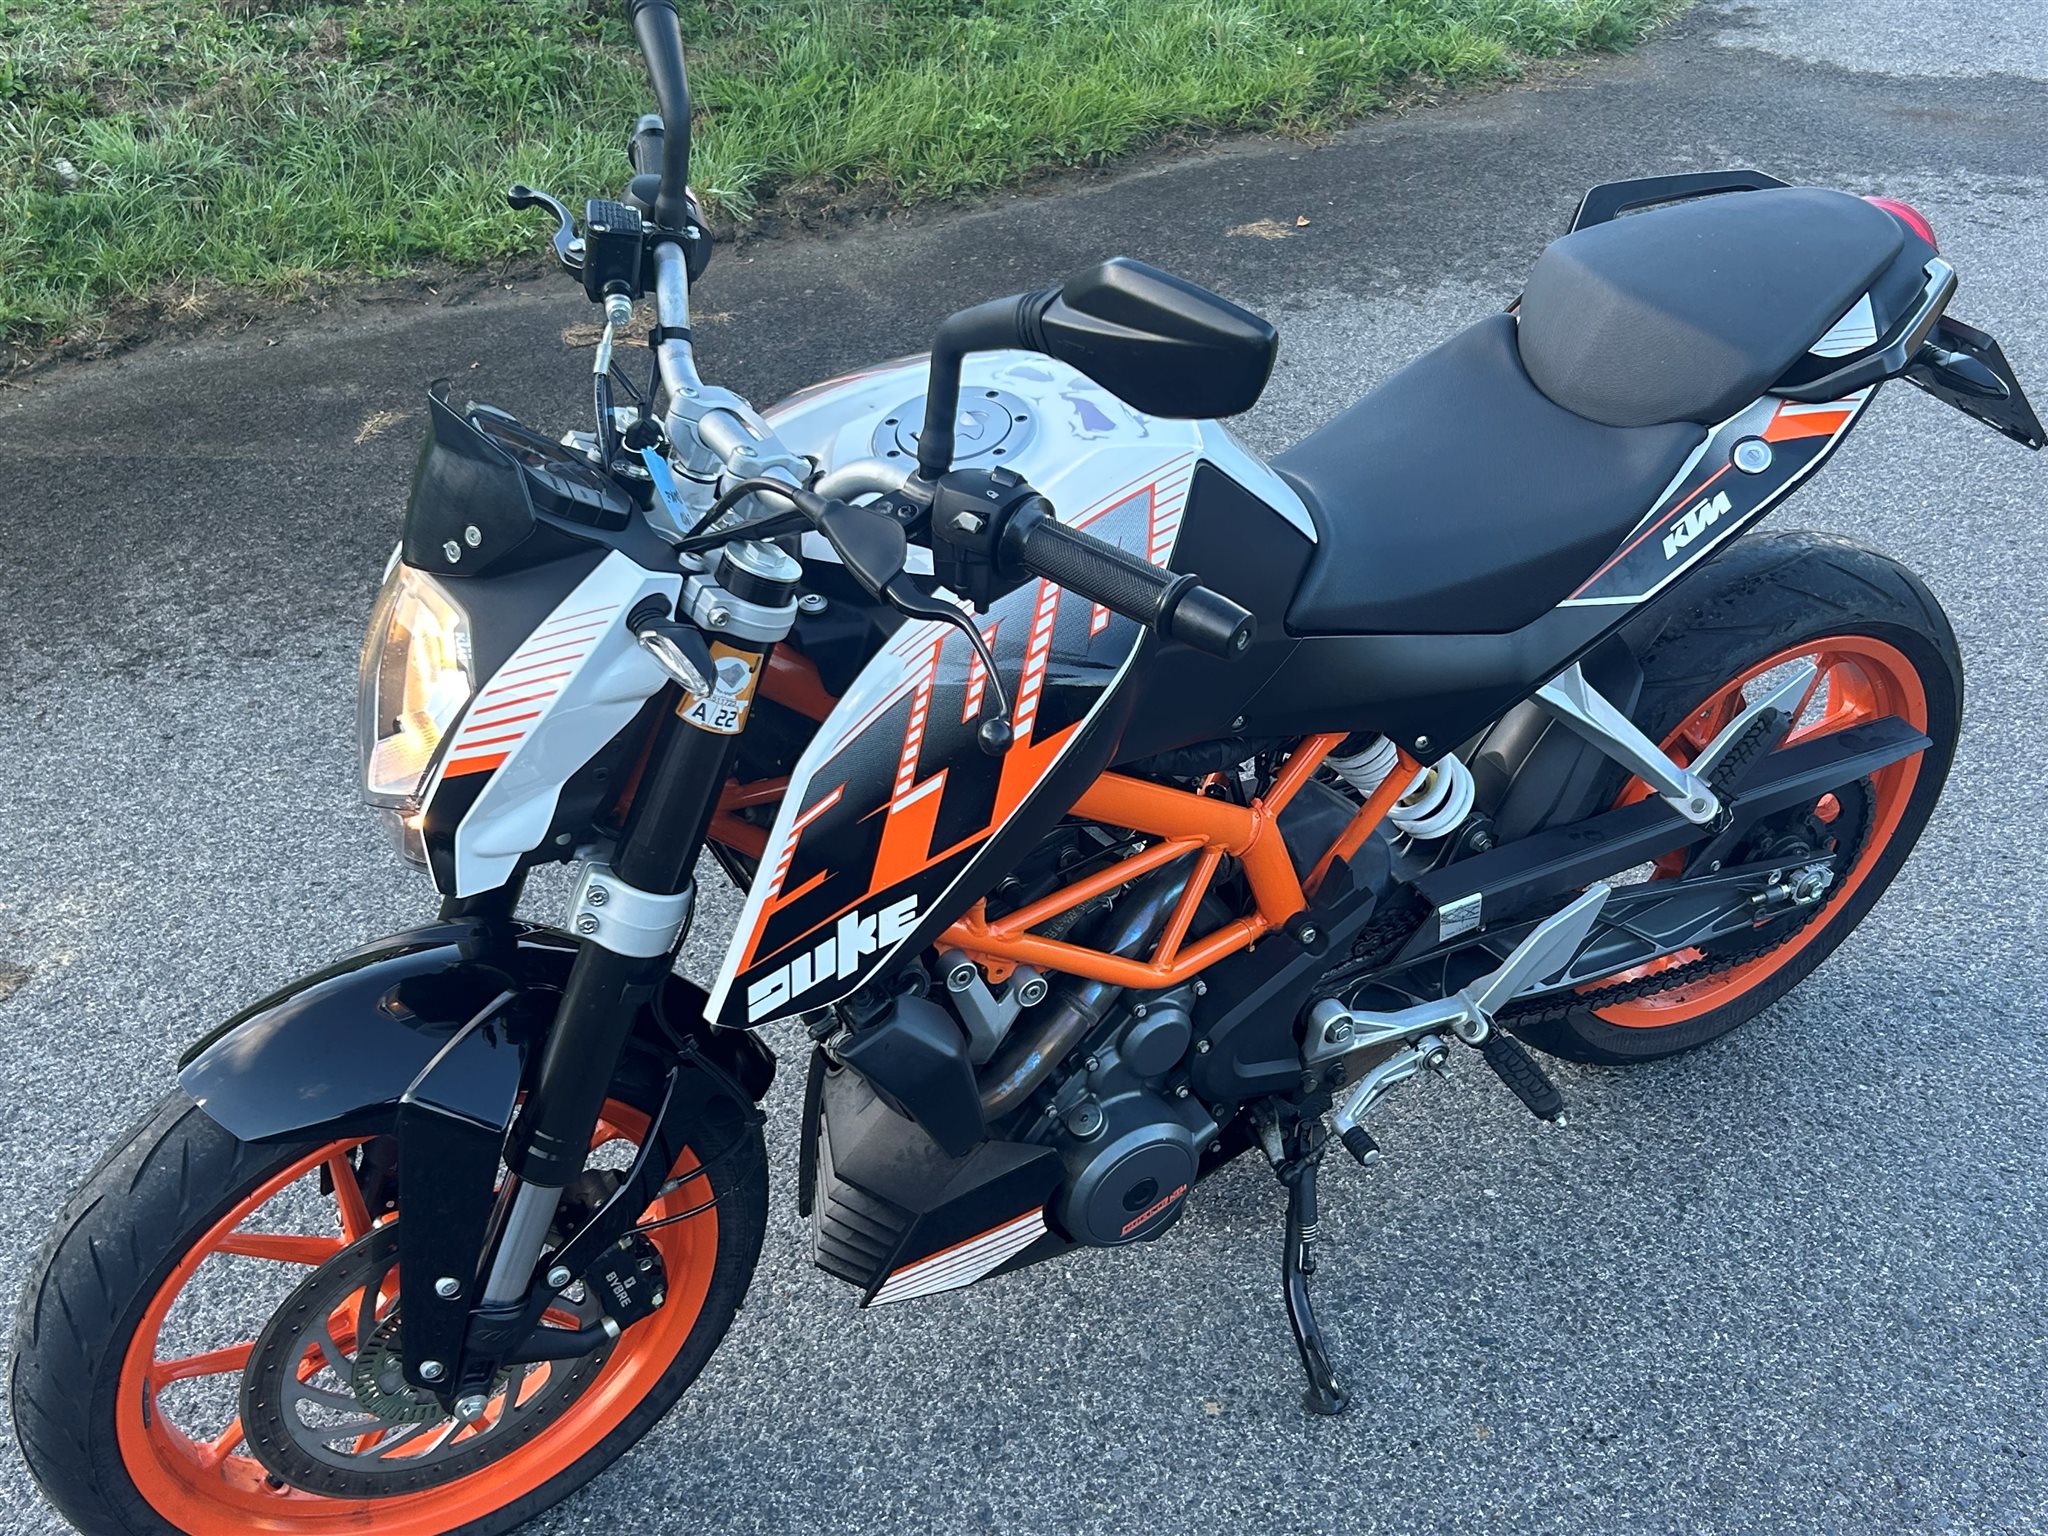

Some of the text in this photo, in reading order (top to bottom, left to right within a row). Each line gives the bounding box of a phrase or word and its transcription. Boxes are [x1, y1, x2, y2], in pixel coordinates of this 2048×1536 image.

[1662, 490, 1732, 560] KTM
[692, 702, 738, 728] A 22
[747, 894, 922, 1023] DUKE
[605, 1271, 632, 1308] BYBRE
